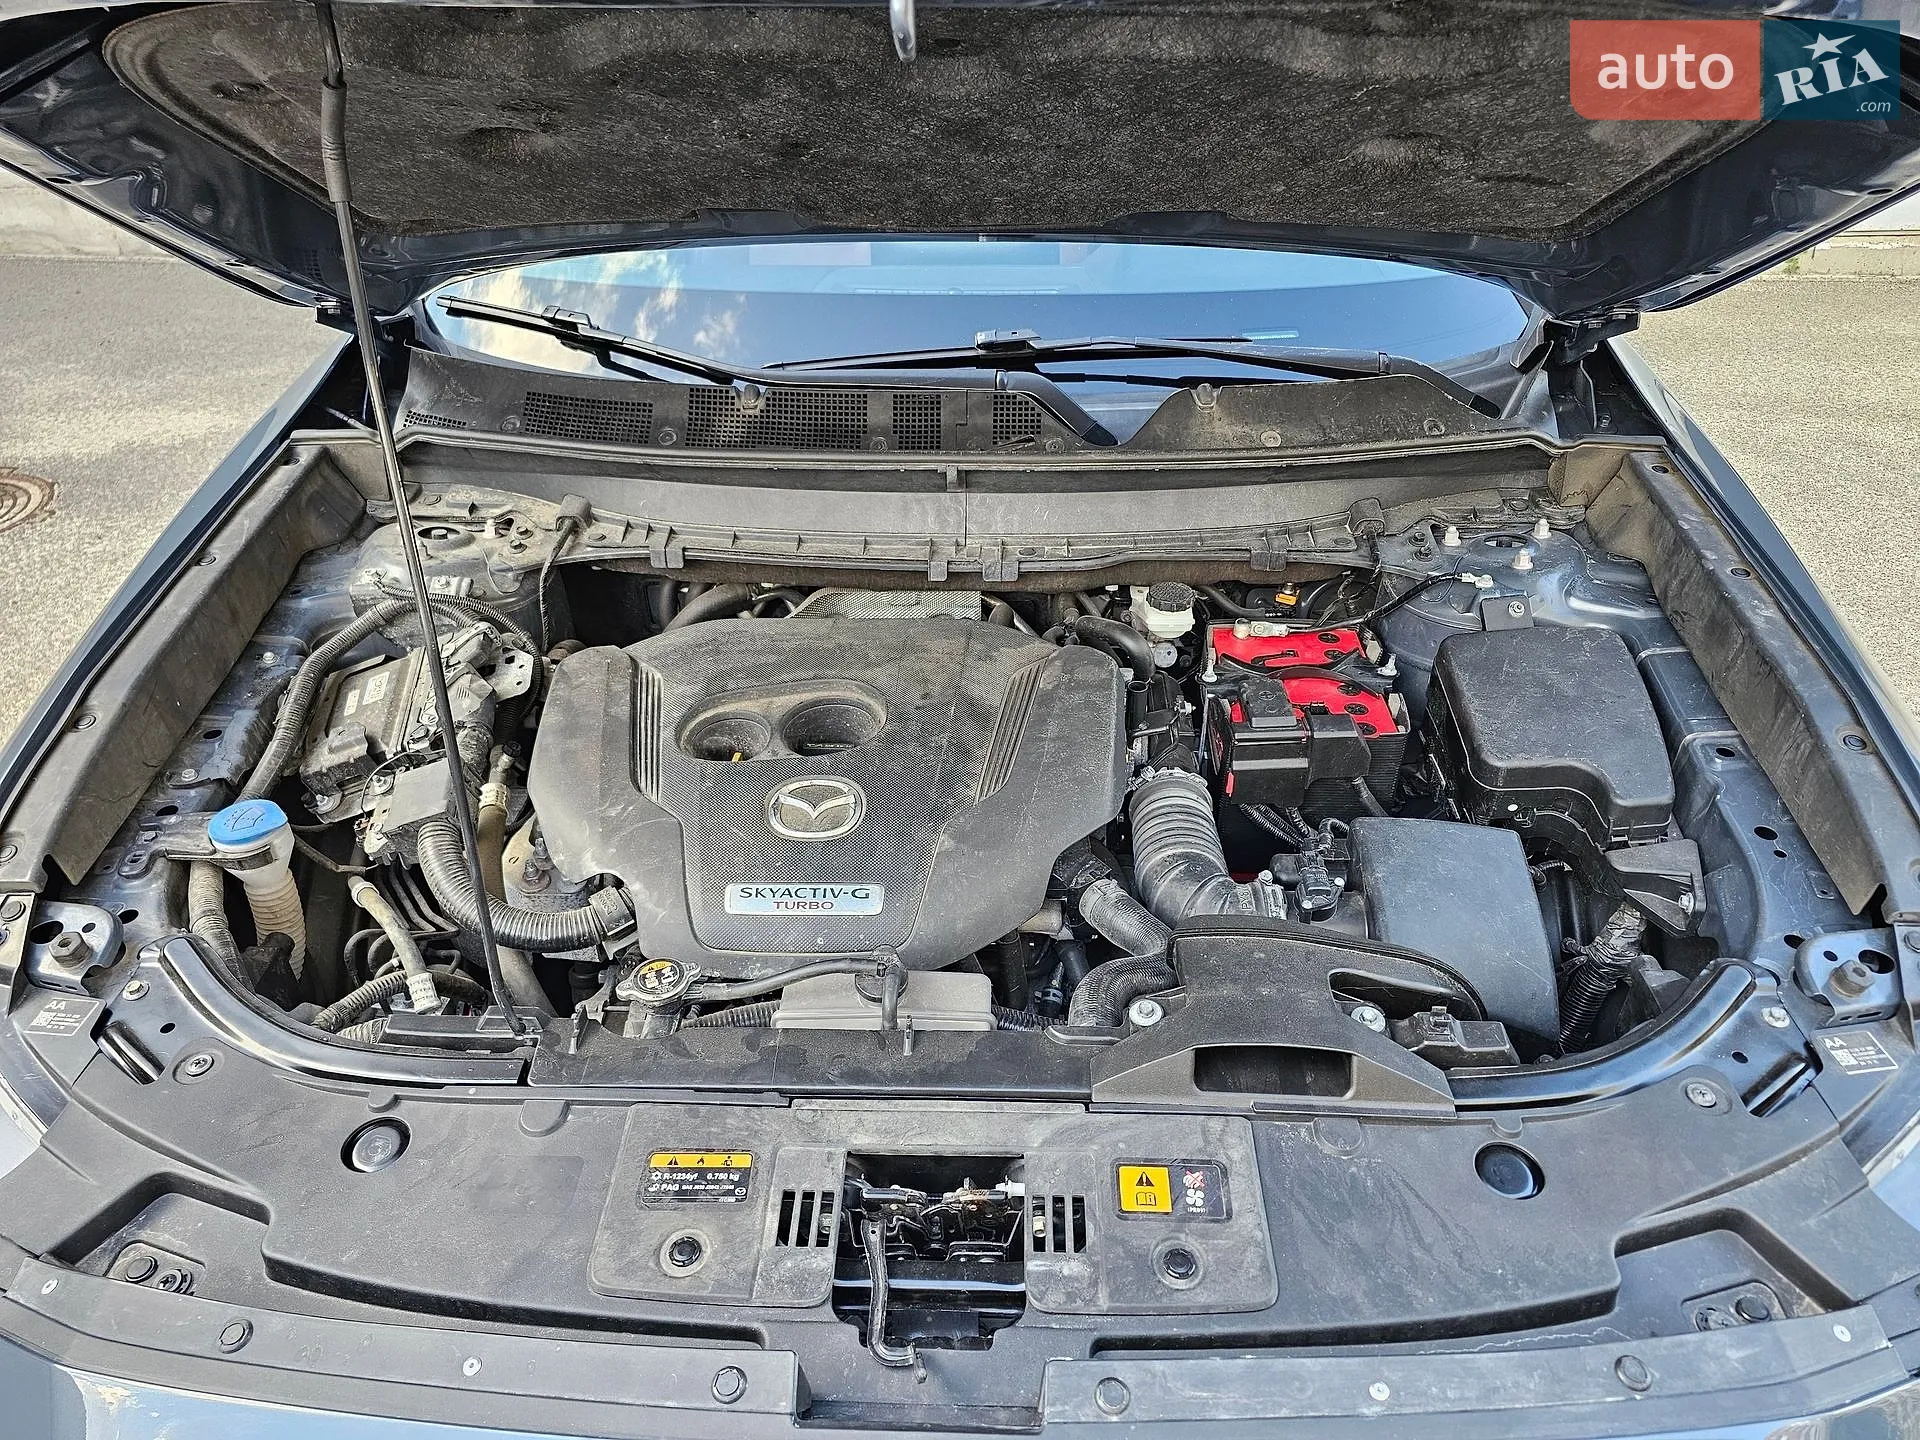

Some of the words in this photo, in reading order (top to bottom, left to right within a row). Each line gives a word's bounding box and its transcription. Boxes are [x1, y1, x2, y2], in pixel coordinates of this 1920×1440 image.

[739, 887, 871, 900] SKYACTIV-G
[773, 901, 835, 910] TURBO
[45, 1001, 66, 1010] AA
[1824, 1037, 1847, 1048] AA
[729, 1172, 740, 1181] kg
